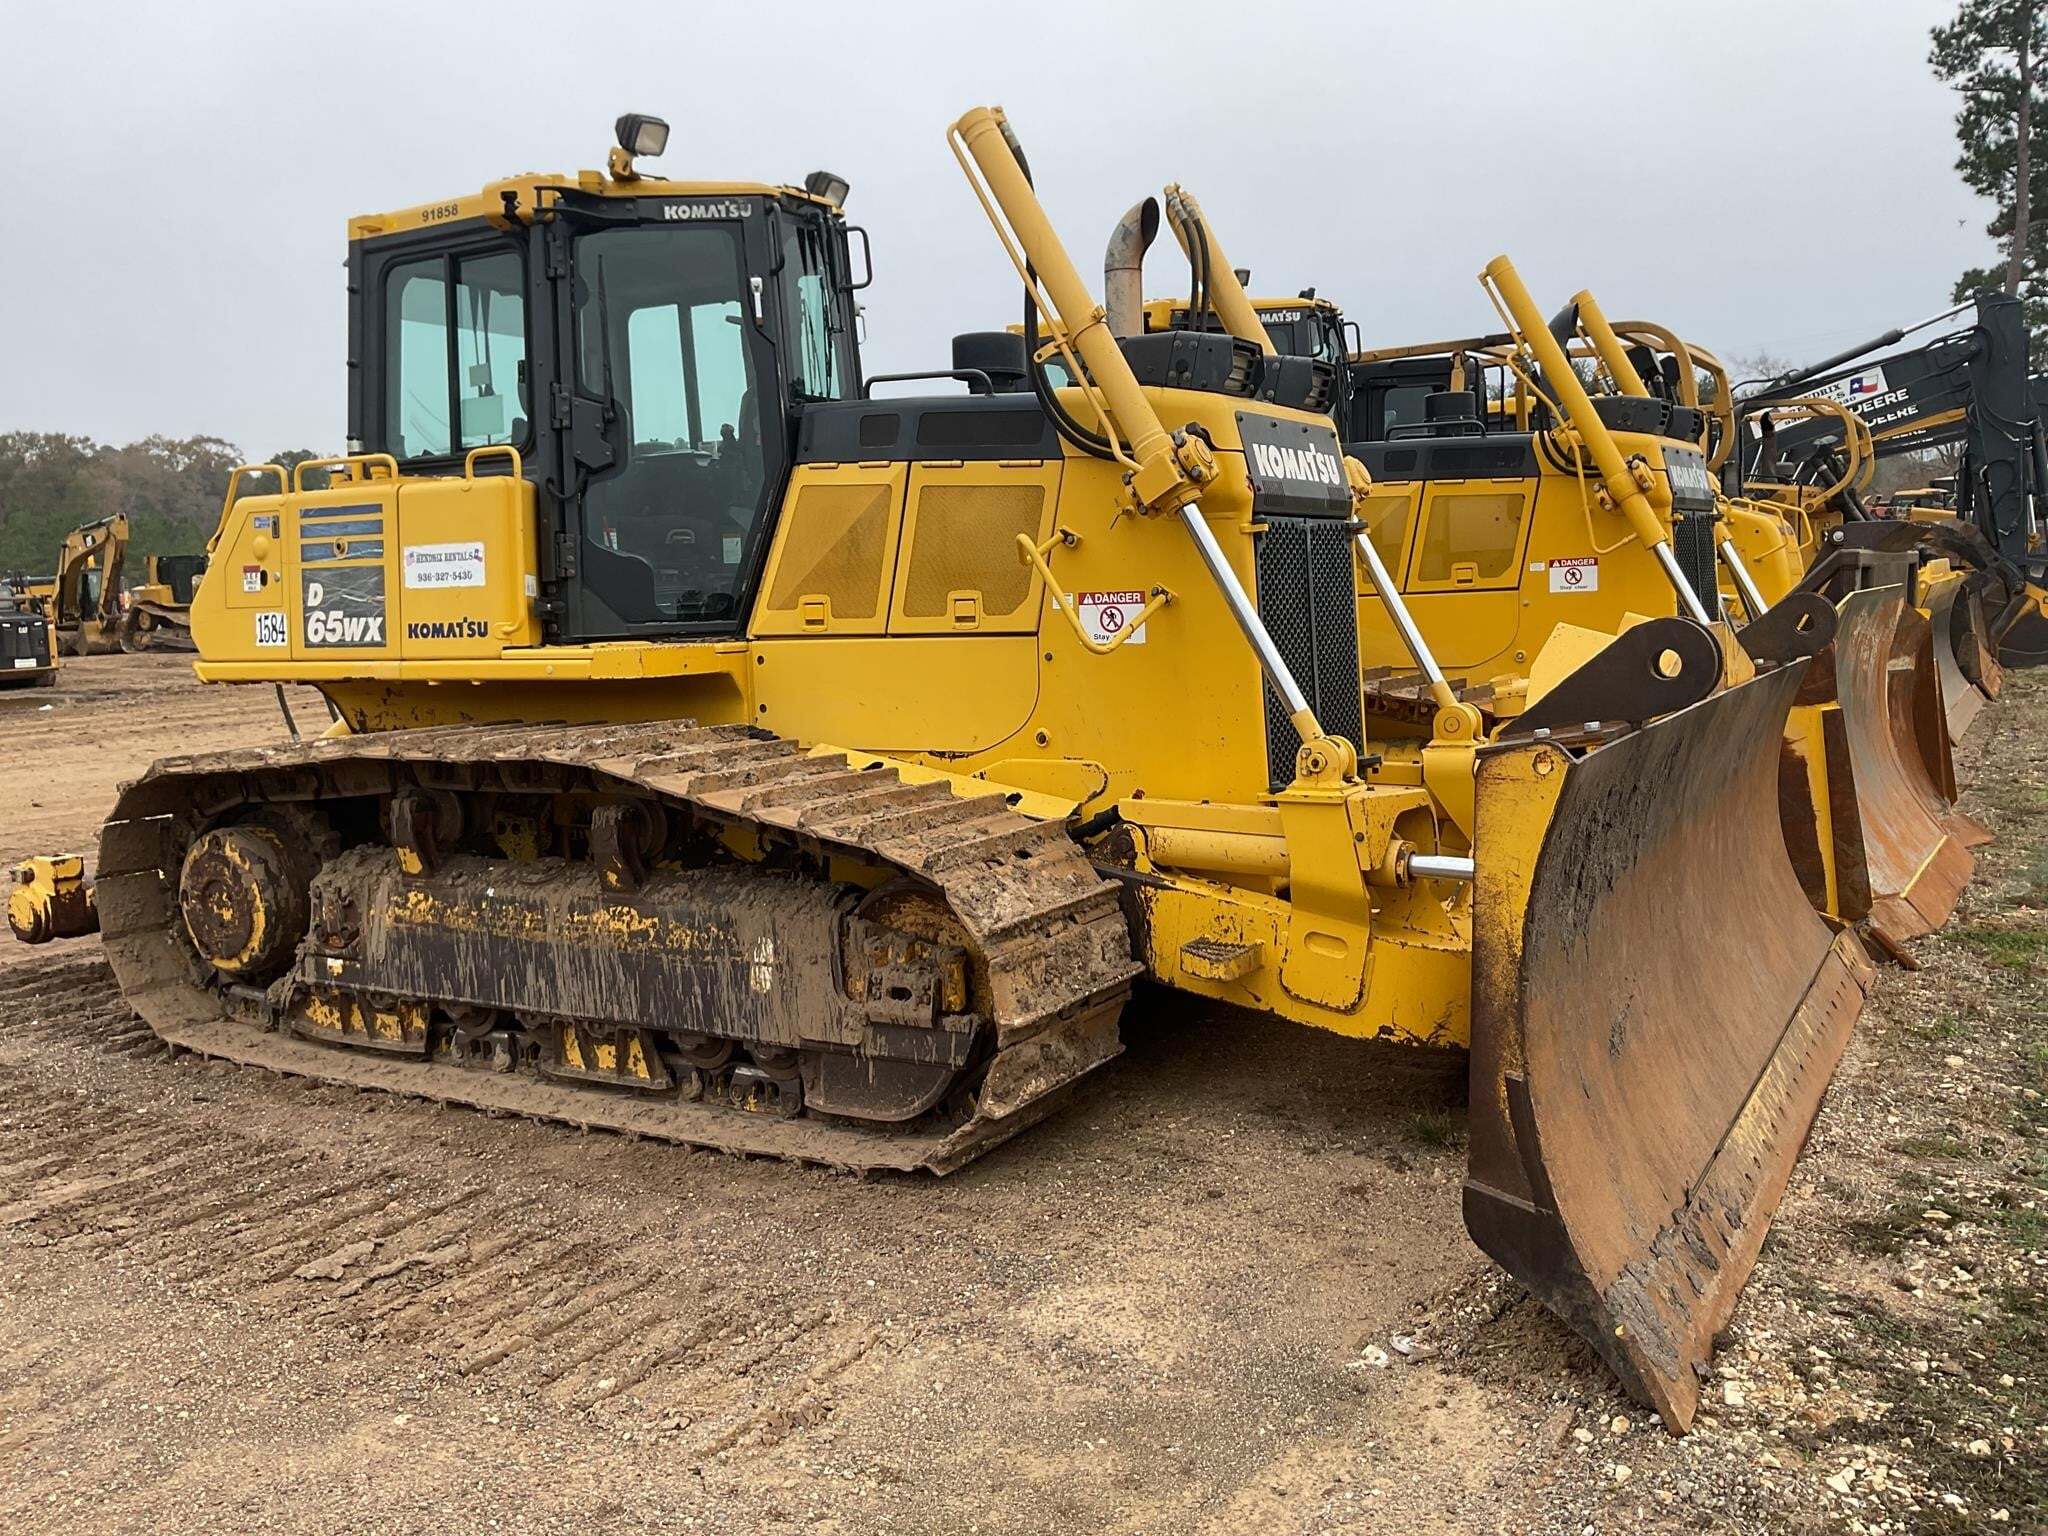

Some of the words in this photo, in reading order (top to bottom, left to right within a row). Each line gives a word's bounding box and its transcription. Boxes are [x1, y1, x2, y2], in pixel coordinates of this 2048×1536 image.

[422, 204, 458, 222] 91858
[664, 201, 752, 219] KOMATSU
[1256, 310, 1301, 322] MATSU
[1253, 443, 1341, 485] KOMATSU
[1669, 463, 1709, 489] KOMATSU
[416, 553, 443, 563] HENDRIX
[445, 551, 474, 562] RENTALS
[1561, 558, 1595, 567] DANGER
[307, 583, 324, 606] D
[1094, 593, 1141, 604] DANGER
[258, 614, 286, 643] 1584
[307, 611, 384, 643] 65WX
[408, 616, 488, 639] KOMATSU
[1093, 633, 1111, 641] Stay
